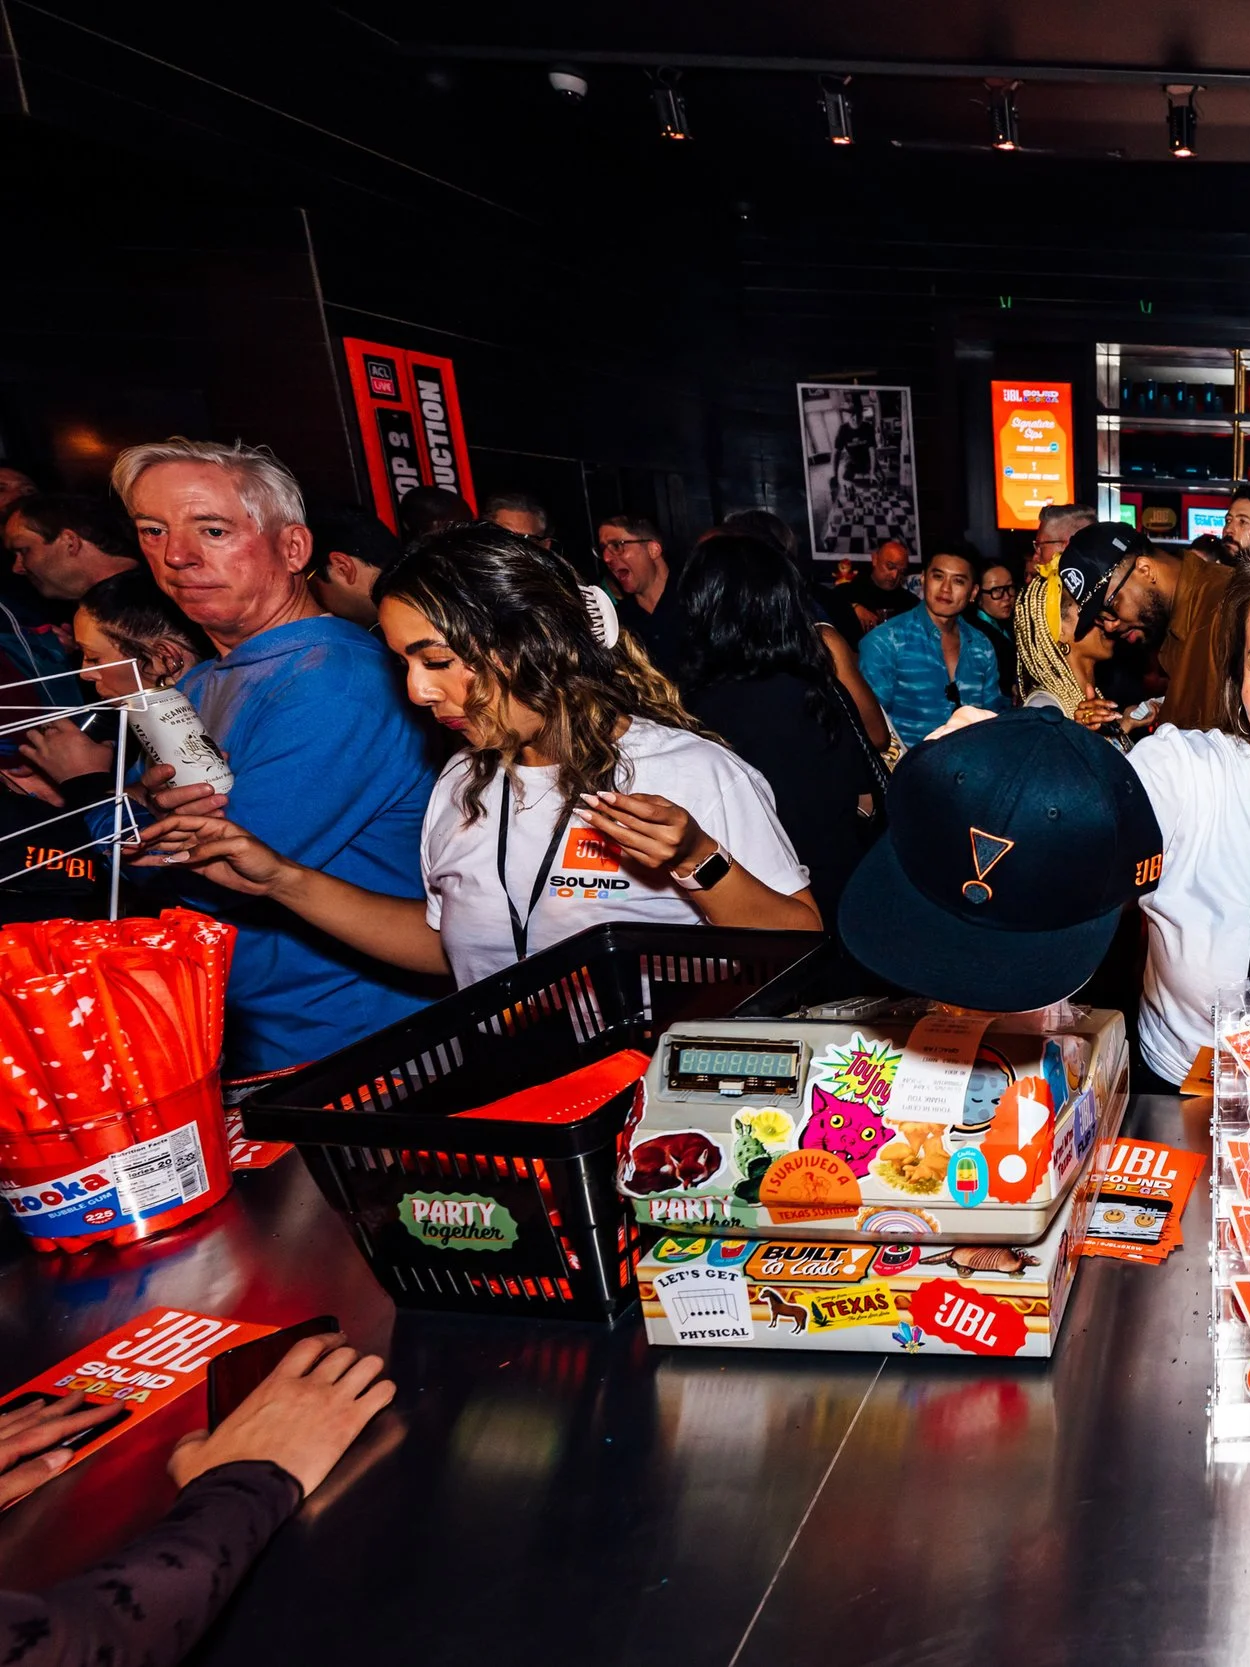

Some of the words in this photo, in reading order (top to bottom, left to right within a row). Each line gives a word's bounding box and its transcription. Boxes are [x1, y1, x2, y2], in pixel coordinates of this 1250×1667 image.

[372, 365, 389, 378] ACL
[391, 456, 420, 503] OP
[549, 875, 631, 890] SOUND
[1134, 853, 1164, 886] JB
[844, 1050, 878, 1086] Toy
[854, 1066, 893, 1107] Joy
[770, 1155, 839, 1187] SURVIVED
[1098, 1144, 1178, 1181] JBL
[8, 1173, 111, 1213] zooka
[1100, 1182, 1170, 1198] ODEGA
[1102, 1174, 1173, 1189] SOUND
[47, 1200, 87, 1220] BUBBLE
[87, 1191, 113, 1206] GUM
[84, 1208, 114, 1223] 225
[410, 1198, 496, 1227] PARTY
[649, 1195, 735, 1222] PARTY
[777, 1209, 811, 1221] TEXAS
[420, 1218, 505, 1246] Together
[760, 1246, 849, 1262] BUILT
[657, 1269, 701, 1288] LET'S
[705, 1269, 739, 1282] GET
[821, 1292, 890, 1318] TEXAS
[934, 1292, 998, 1347] JBL
[106, 1311, 241, 1374] JBL
[680, 1327, 750, 1340] PHYSICAL
[53, 1374, 153, 1403] BODEGA
[75, 1360, 176, 1390] SOUND
